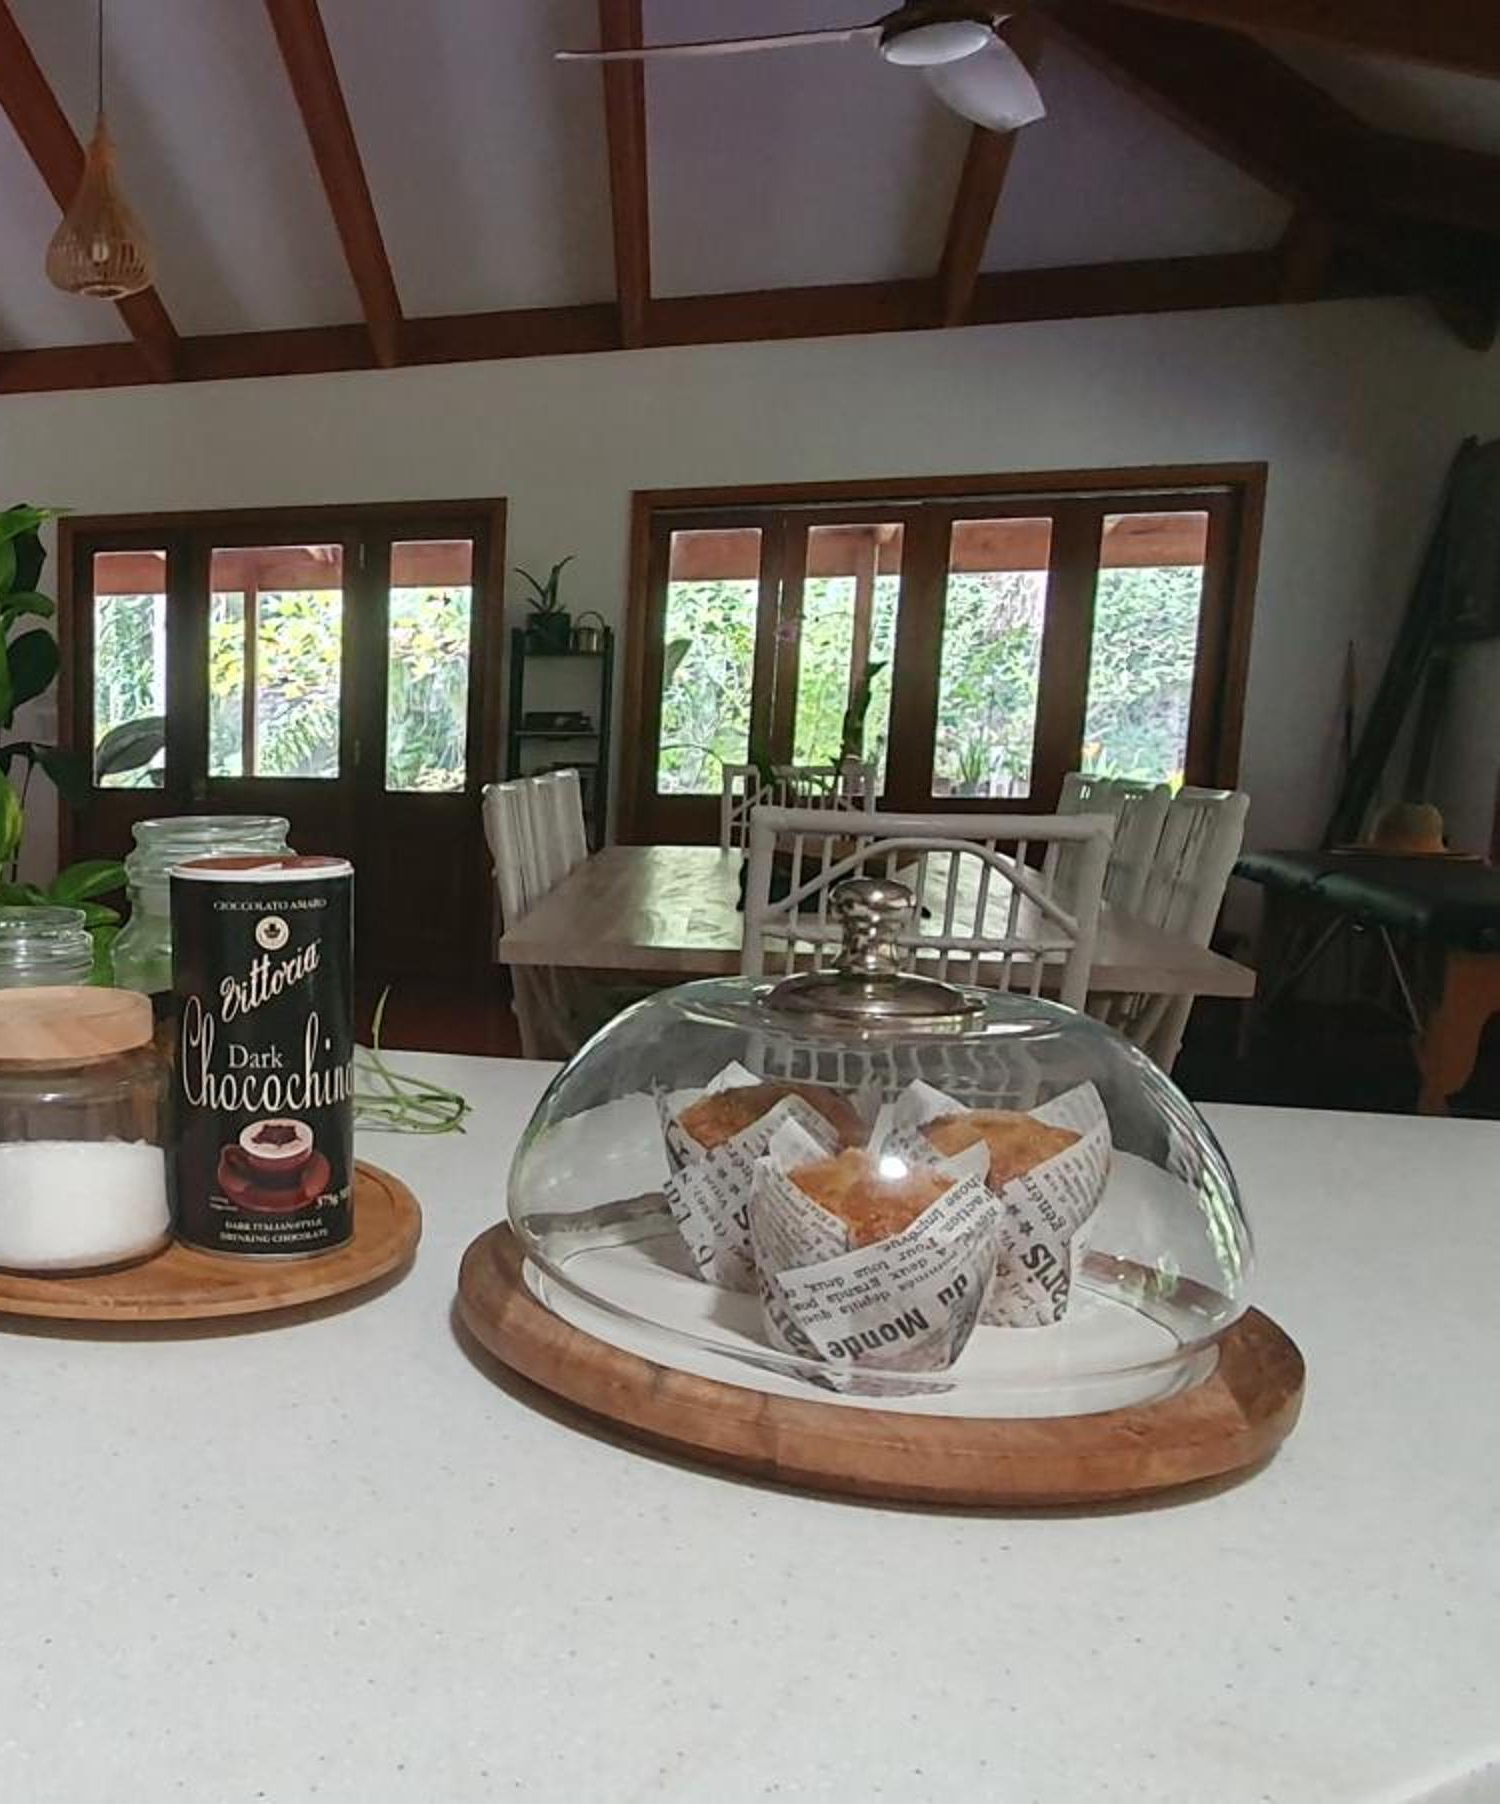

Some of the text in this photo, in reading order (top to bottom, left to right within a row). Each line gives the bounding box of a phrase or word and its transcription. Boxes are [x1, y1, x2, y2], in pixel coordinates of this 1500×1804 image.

[219, 943, 321, 1023] Vittoria
[228, 1044, 284, 1069] Dark
[937, 1272, 969, 1307] du
[826, 1306, 930, 1361] Monde
